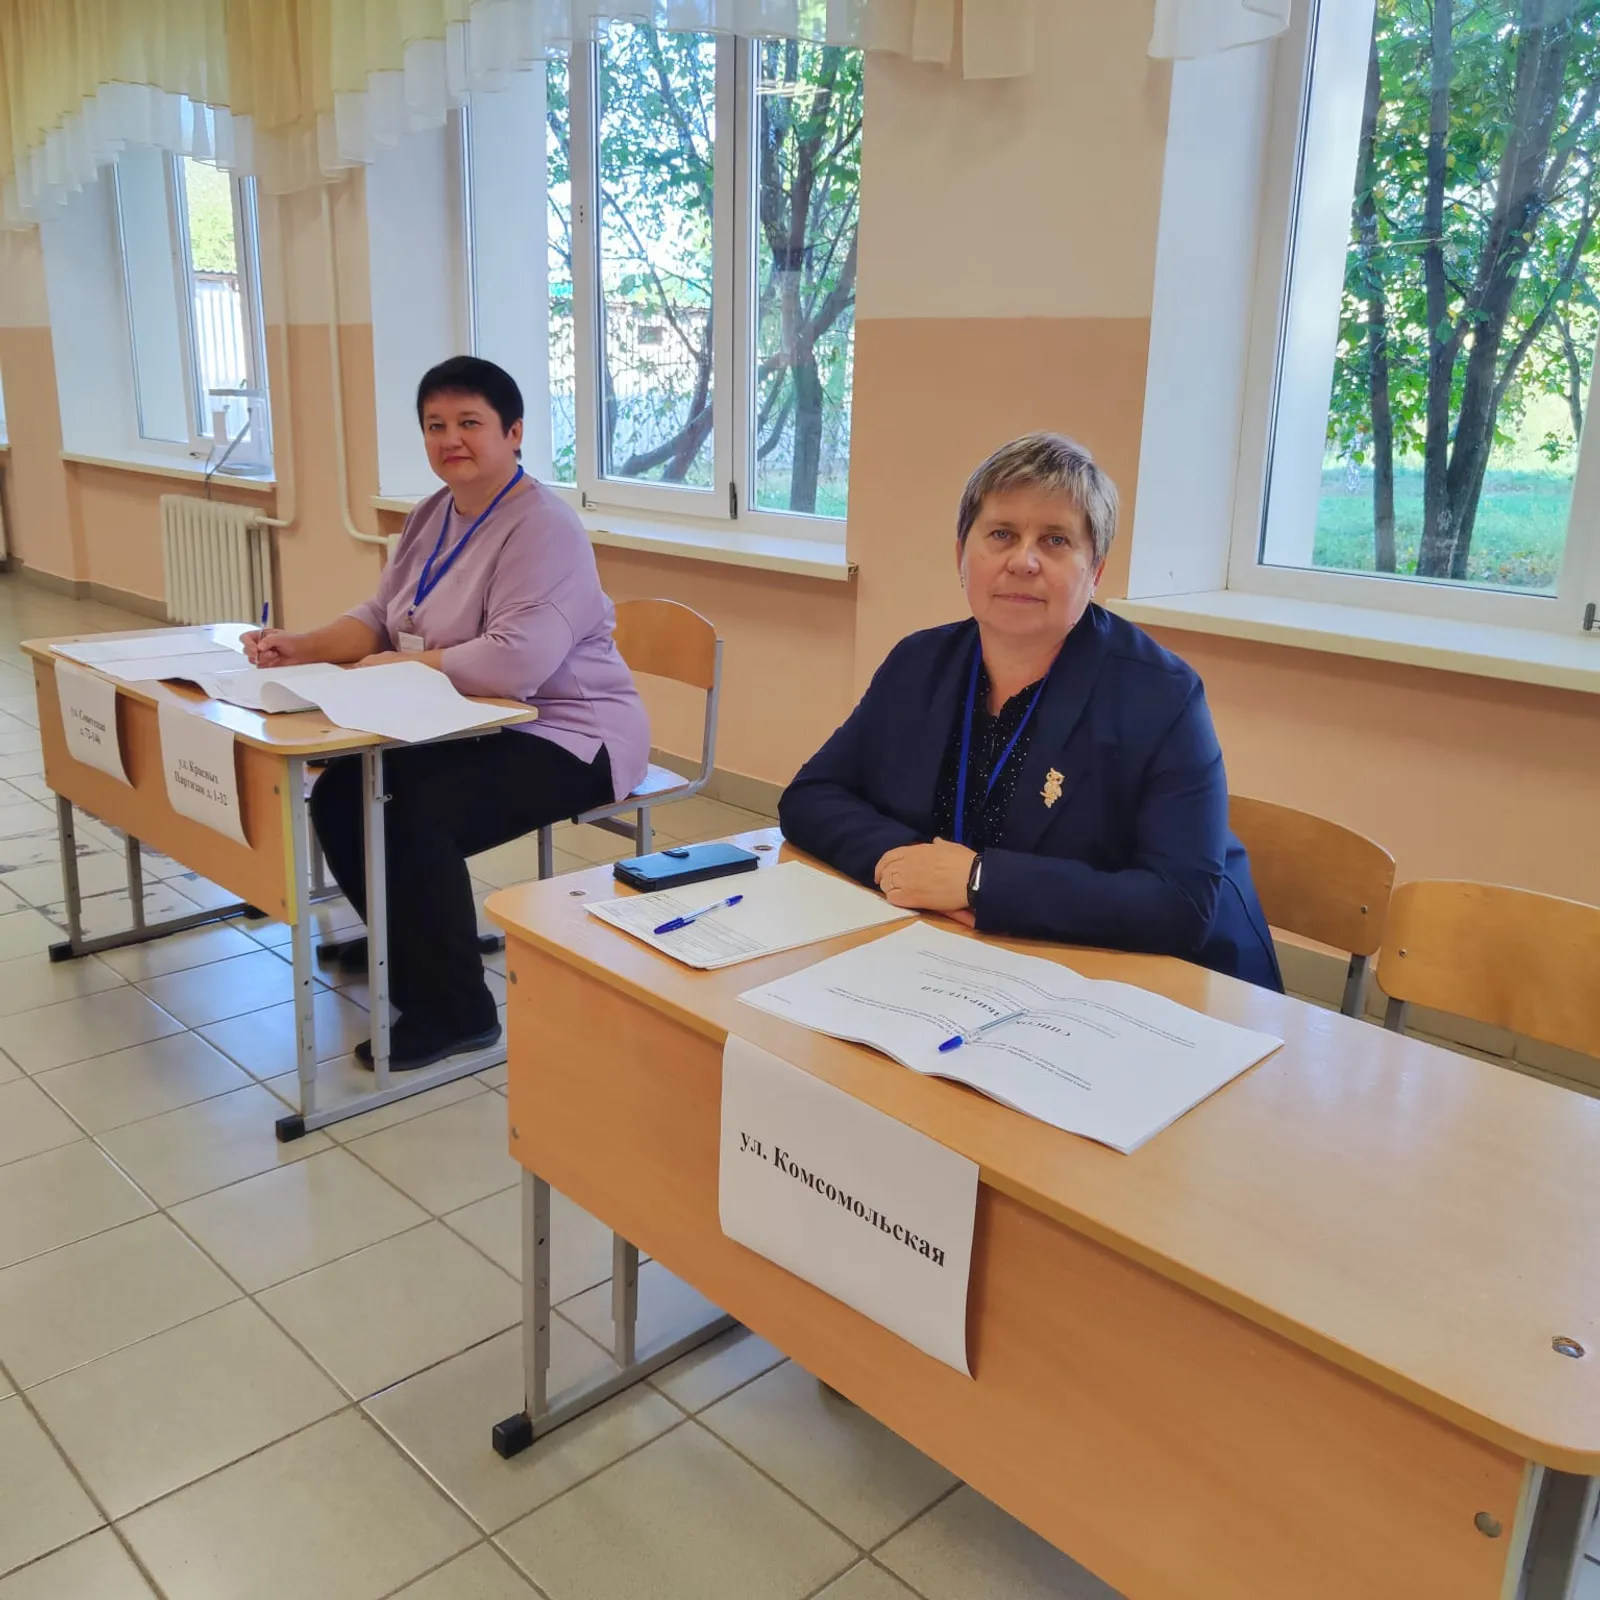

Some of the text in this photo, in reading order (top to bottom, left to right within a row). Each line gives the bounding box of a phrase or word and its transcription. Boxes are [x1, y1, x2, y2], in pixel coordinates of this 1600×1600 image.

[189, 760, 219, 785] Красных
[740, 1131, 946, 1267] ул. Комсомольская
